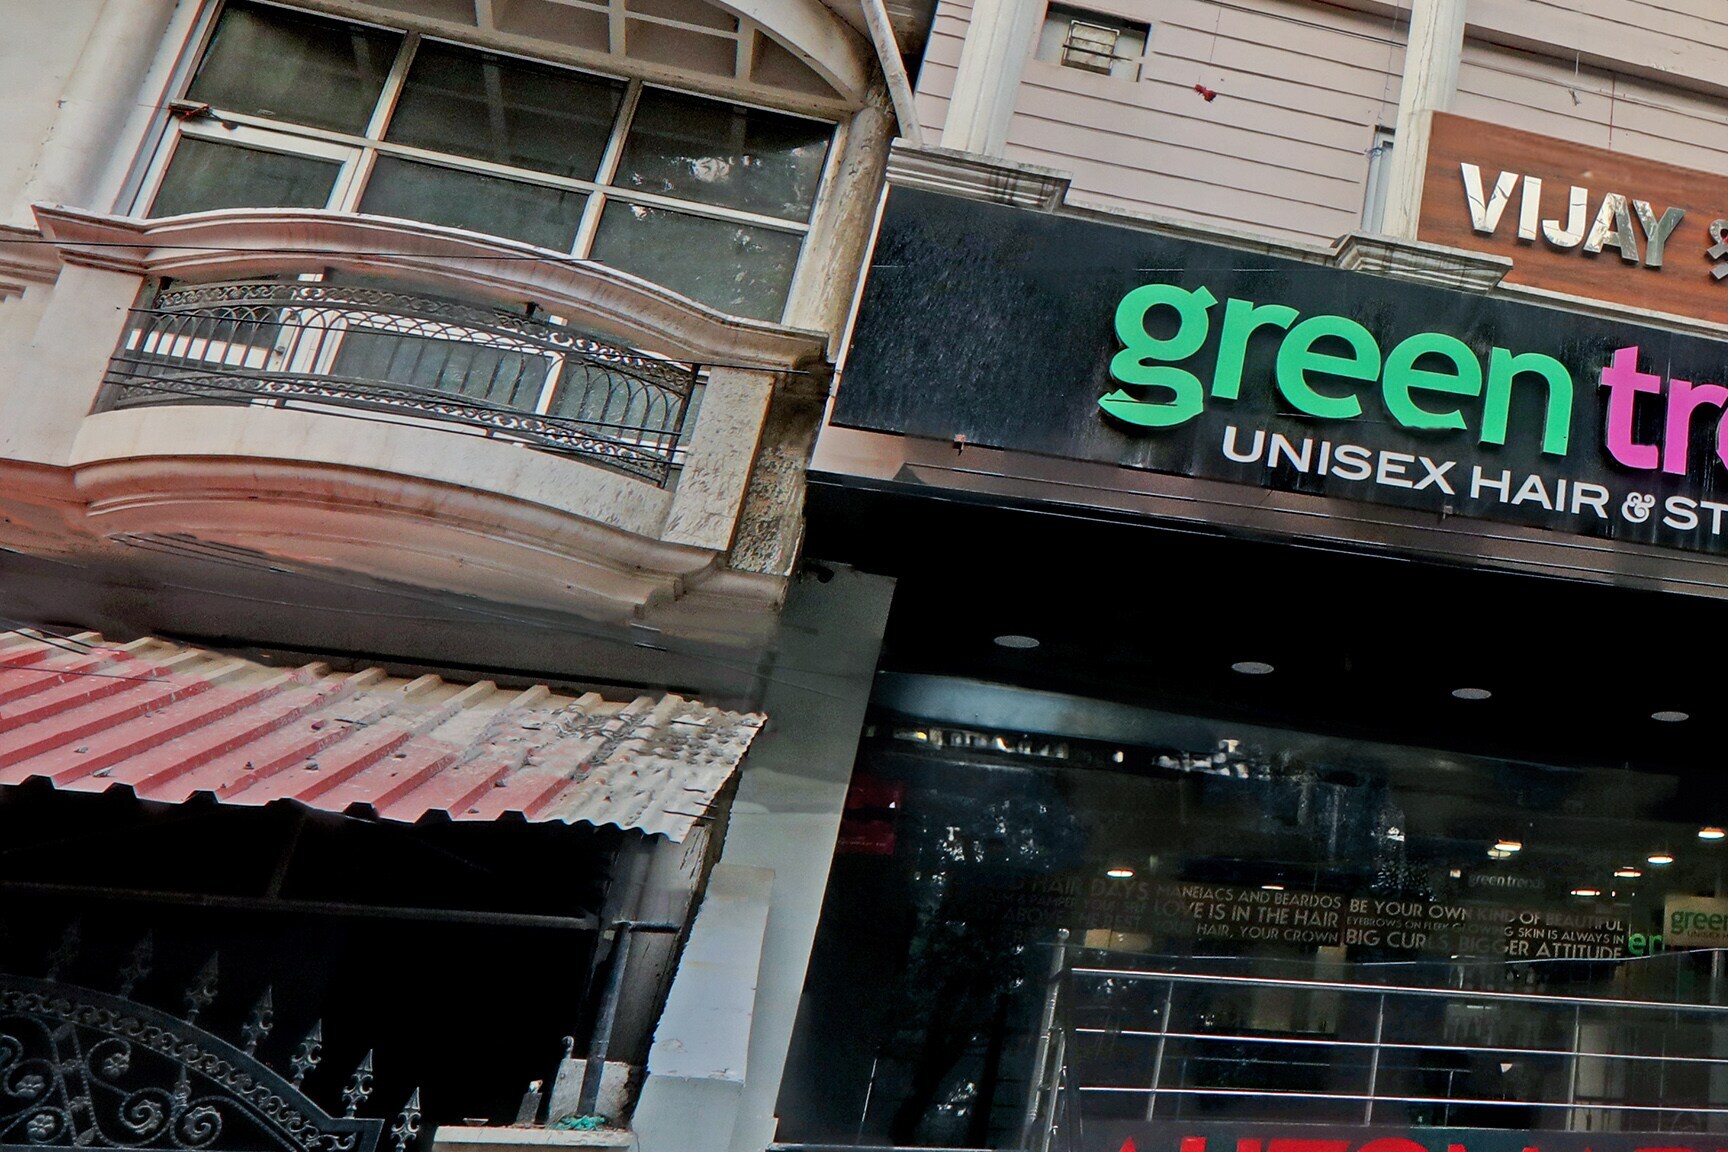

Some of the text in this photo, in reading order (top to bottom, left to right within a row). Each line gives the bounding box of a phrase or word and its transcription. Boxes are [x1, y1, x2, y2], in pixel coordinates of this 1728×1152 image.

[1460, 162, 1687, 268] VIJAY
[1098, 284, 1573, 455] green
[1222, 426, 1456, 494] UNISEX
[1470, 467, 1608, 518] HAIR
[1622, 491, 1656, 523] &
[1238, 890, 1270, 904] AND
[1275, 892, 1342, 909] BEARDOS
[1350, 898, 1369, 914] BE
[1375, 900, 1422, 918] YOUR
[1428, 904, 1474, 922] OWN
[1519, 910, 1541, 926] OF
[1209, 903, 1226, 921] IS
[1232, 905, 1250, 922] IN
[1258, 906, 1290, 925] THE
[1294, 909, 1339, 928] HAIR
[1239, 925, 1279, 940] YOUR
[1283, 929, 1339, 943] CROWN
[1346, 917, 1401, 928] EYEBROWS
[1404, 920, 1422, 930] ON
[1518, 926, 1546, 939] SKIN
[1547, 928, 1558, 940] IS
[1561, 930, 1610, 944] ALWAYS
[1613, 935, 1624, 945] IN
[1346, 928, 1381, 946] BIG
[1535, 941, 1623, 960] ATTITUDE
